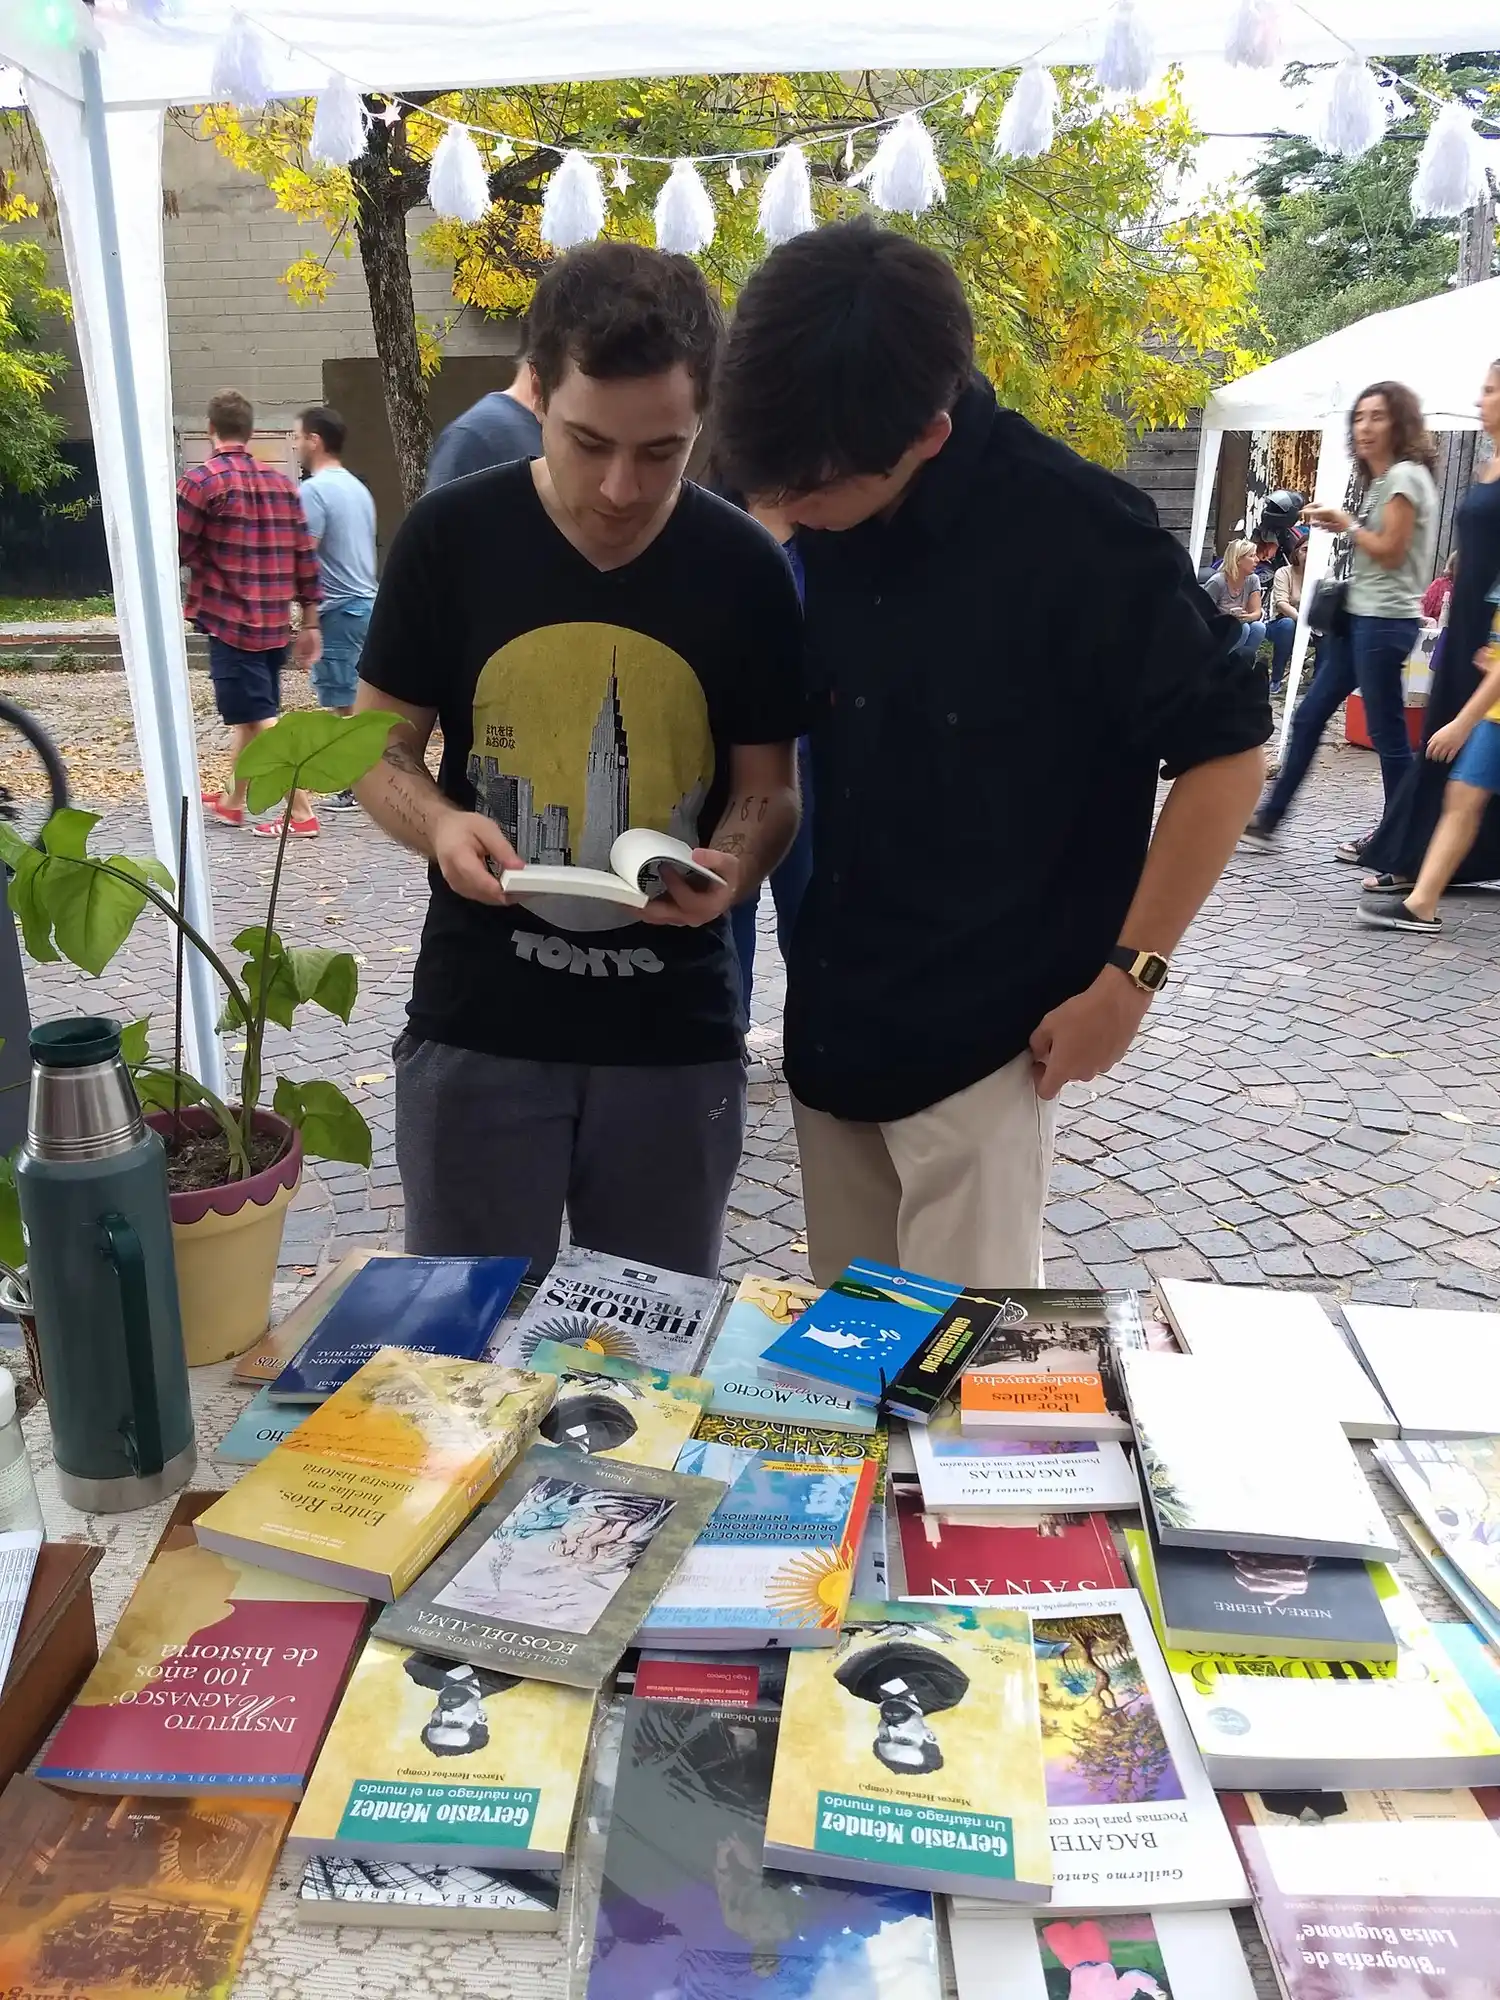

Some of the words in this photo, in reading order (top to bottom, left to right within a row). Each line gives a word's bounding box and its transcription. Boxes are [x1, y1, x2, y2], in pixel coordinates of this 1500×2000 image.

[552, 1277, 685, 1318] TRAIDORES
[542, 1288, 698, 1338] HÉROES
[691, 1309, 702, 1320] Y
[972, 1374, 1099, 1386] Gualeguaychú
[1039, 1385, 1058, 1393] de
[800, 1392, 852, 1410] FRAY
[991, 1392, 1049, 1404] calles
[1054, 1393, 1080, 1404] las
[1037, 1402, 1070, 1412] Por
[1014, 1460, 1035, 1468] leer
[1037, 1457, 1060, 1466] para
[1060, 1457, 1101, 1466] Poemas
[302, 1463, 357, 1484] historia
[968, 1467, 1076, 1479] BAGATELAS
[307, 1480, 326, 1490] en
[360, 1476, 414, 1493] nuestra
[1037, 1486, 1094, 1495] Guillermo
[327, 1485, 383, 1506] huellas
[330, 1502, 387, 1527] Entre
[763, 1523, 788, 1532] DEL
[819, 1533, 834, 1541] LA
[1214, 1601, 1272, 1615] LIEBRE
[1275, 1605, 1333, 1619] NEREA
[417, 1610, 476, 1635] ALMA
[445, 1634, 495, 1650] SANTOS
[478, 1625, 519, 1645] DEL
[518, 1631, 578, 1655] ECOS
[159, 1643, 274, 1667] historia
[281, 1647, 318, 1667] de
[498, 1646, 568, 1667] GUILLERMO
[135, 1664, 198, 1685] años
[203, 1667, 253, 1687] 100
[164, 1713, 297, 1734] INSTITUTO
[710, 1711, 756, 1724] Delcanto
[65, 1769, 176, 1782] CENTENARIO
[187, 1773, 216, 1783] DEL
[228, 1774, 278, 1784] SERIE
[396, 1768, 431, 1778] (comp.)
[432, 1770, 470, 1780] Henchoz
[472, 1772, 506, 1781] Marcos
[359, 1784, 407, 1797] mundo
[409, 1787, 423, 1798] el
[426, 1787, 444, 1797] en
[447, 1785, 510, 1802] náufrago
[858, 1782, 893, 1796] (comp.)
[895, 1789, 935, 1802] Henchoz
[514, 1791, 532, 1803] Un
[825, 1795, 875, 1813] mundo
[936, 1794, 973, 1807] Marcos
[349, 1798, 432, 1824] Méndez
[437, 1802, 529, 1828] Gervasio
[878, 1805, 891, 1819] el
[894, 1807, 913, 1820] en
[1102, 1809, 1132, 1824] para
[1135, 1810, 1188, 1826] Poemas
[916, 1809, 981, 1830] náufrago
[986, 1819, 1006, 1832] Un
[1073, 1815, 1100, 1829] leer
[821, 1811, 904, 1845] Méndez
[910, 1825, 1008, 1858] Gervasio
[1105, 1867, 1183, 1882] Guillermo
[338, 1889, 423, 1901] LIEBRE
[440, 1892, 516, 1905] NEREA
[1399, 1926, 1459, 1949] Luisa
[1300, 1950, 1329, 1969] de
